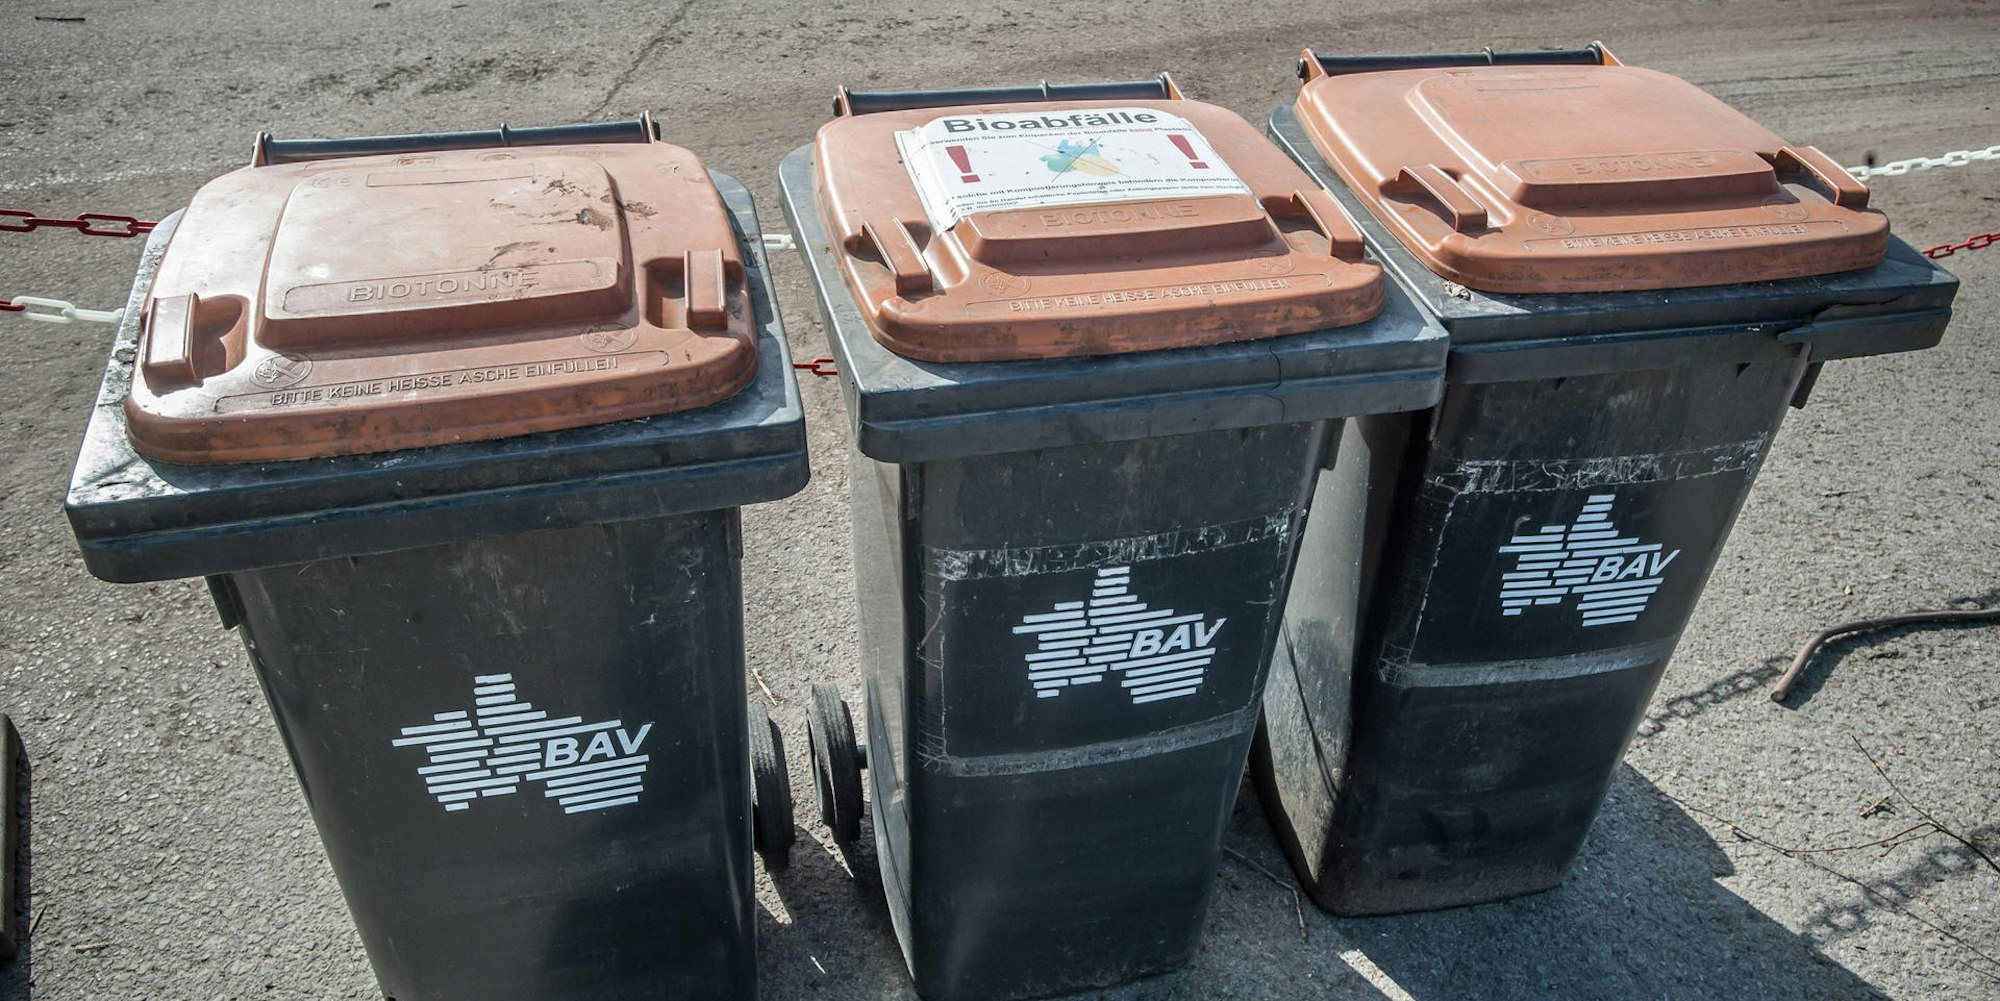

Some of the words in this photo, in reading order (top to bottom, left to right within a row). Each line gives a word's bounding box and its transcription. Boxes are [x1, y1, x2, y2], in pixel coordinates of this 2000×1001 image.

[943, 112, 1158, 133] Bioabfälle
[1040, 204, 1199, 228] BIOTONNE
[348, 270, 541, 302] BIOTONNE
[1009, 299, 1051, 313] BITTE
[1102, 289, 1156, 304] HEISSE
[1161, 285, 1210, 298] ASCHE
[270, 389, 322, 406] BITTE
[328, 382, 382, 399] KEINE
[387, 374, 453, 392] HEISSE
[457, 366, 519, 385] ASCHE
[1590, 549, 1681, 582] BAV
[1129, 618, 1227, 658] BAV
[545, 723, 653, 768] BAV
